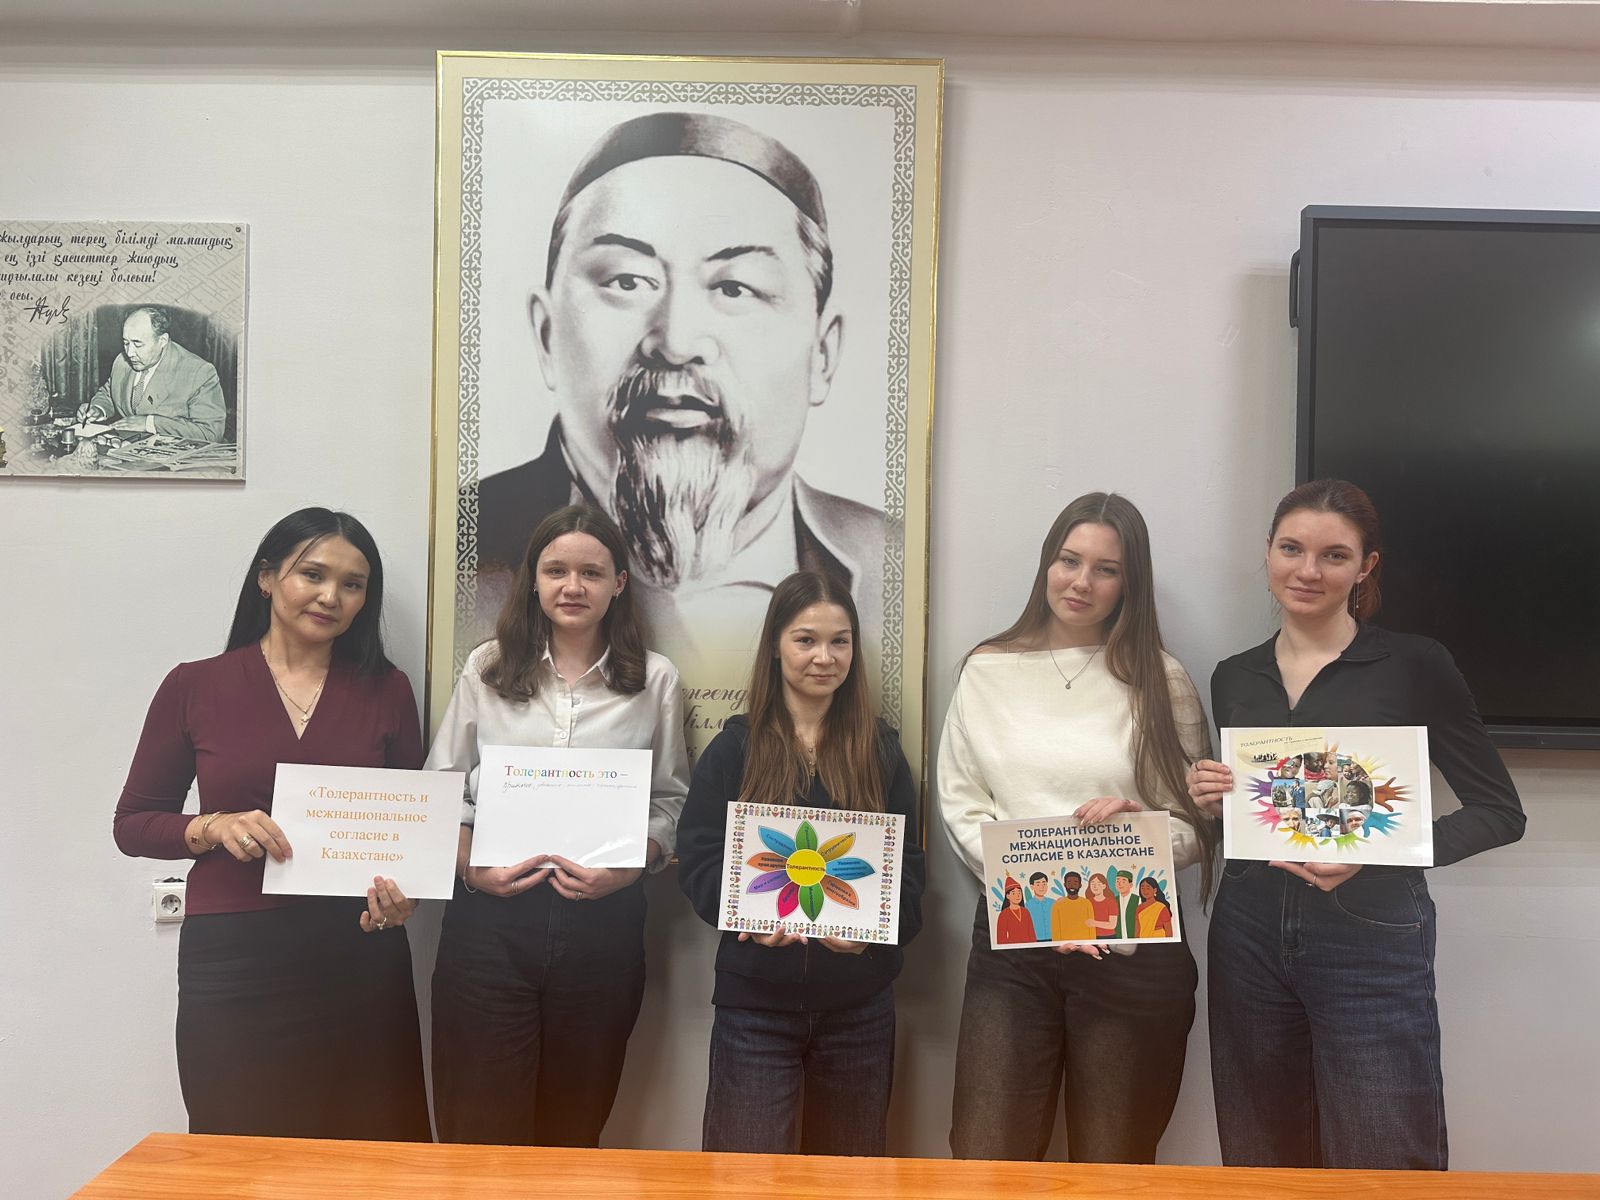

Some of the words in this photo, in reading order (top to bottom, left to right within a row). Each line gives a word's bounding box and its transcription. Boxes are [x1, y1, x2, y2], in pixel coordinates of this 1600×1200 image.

[70, 235, 107, 248] терең
[115, 230, 159, 250] білімді
[166, 236, 234, 250] мамандық
[4, 254, 18, 267] ең
[26, 250, 46, 268] ізгі
[53, 254, 118, 267] қасиеттер
[126, 251, 179, 269] жиюдың
[66, 270, 103, 287] кезеңі
[110, 268, 157, 283] болсын!
[505, 765, 595, 780] Толерантность
[598, 770, 618, 779] это
[309, 786, 416, 803] «Толерантность
[420, 794, 428, 803] и
[306, 809, 428, 823] межнациональное
[330, 830, 388, 841] согласие
[392, 833, 400, 841] в
[1017, 824, 1120, 839] ТОЛЕРАНТНОСТЬ
[1123, 823, 1132, 833] И
[1009, 835, 1141, 851] МЕЖНАЦИОНАЛЬНОЕ
[321, 847, 404, 862] Казахстане»
[1002, 851, 1064, 864] СОГЛАСИЕ
[1067, 850, 1074, 860] В
[1077, 847, 1155, 860] КАЗАХСТАНЕ
[786, 863, 826, 873] Толерантность
